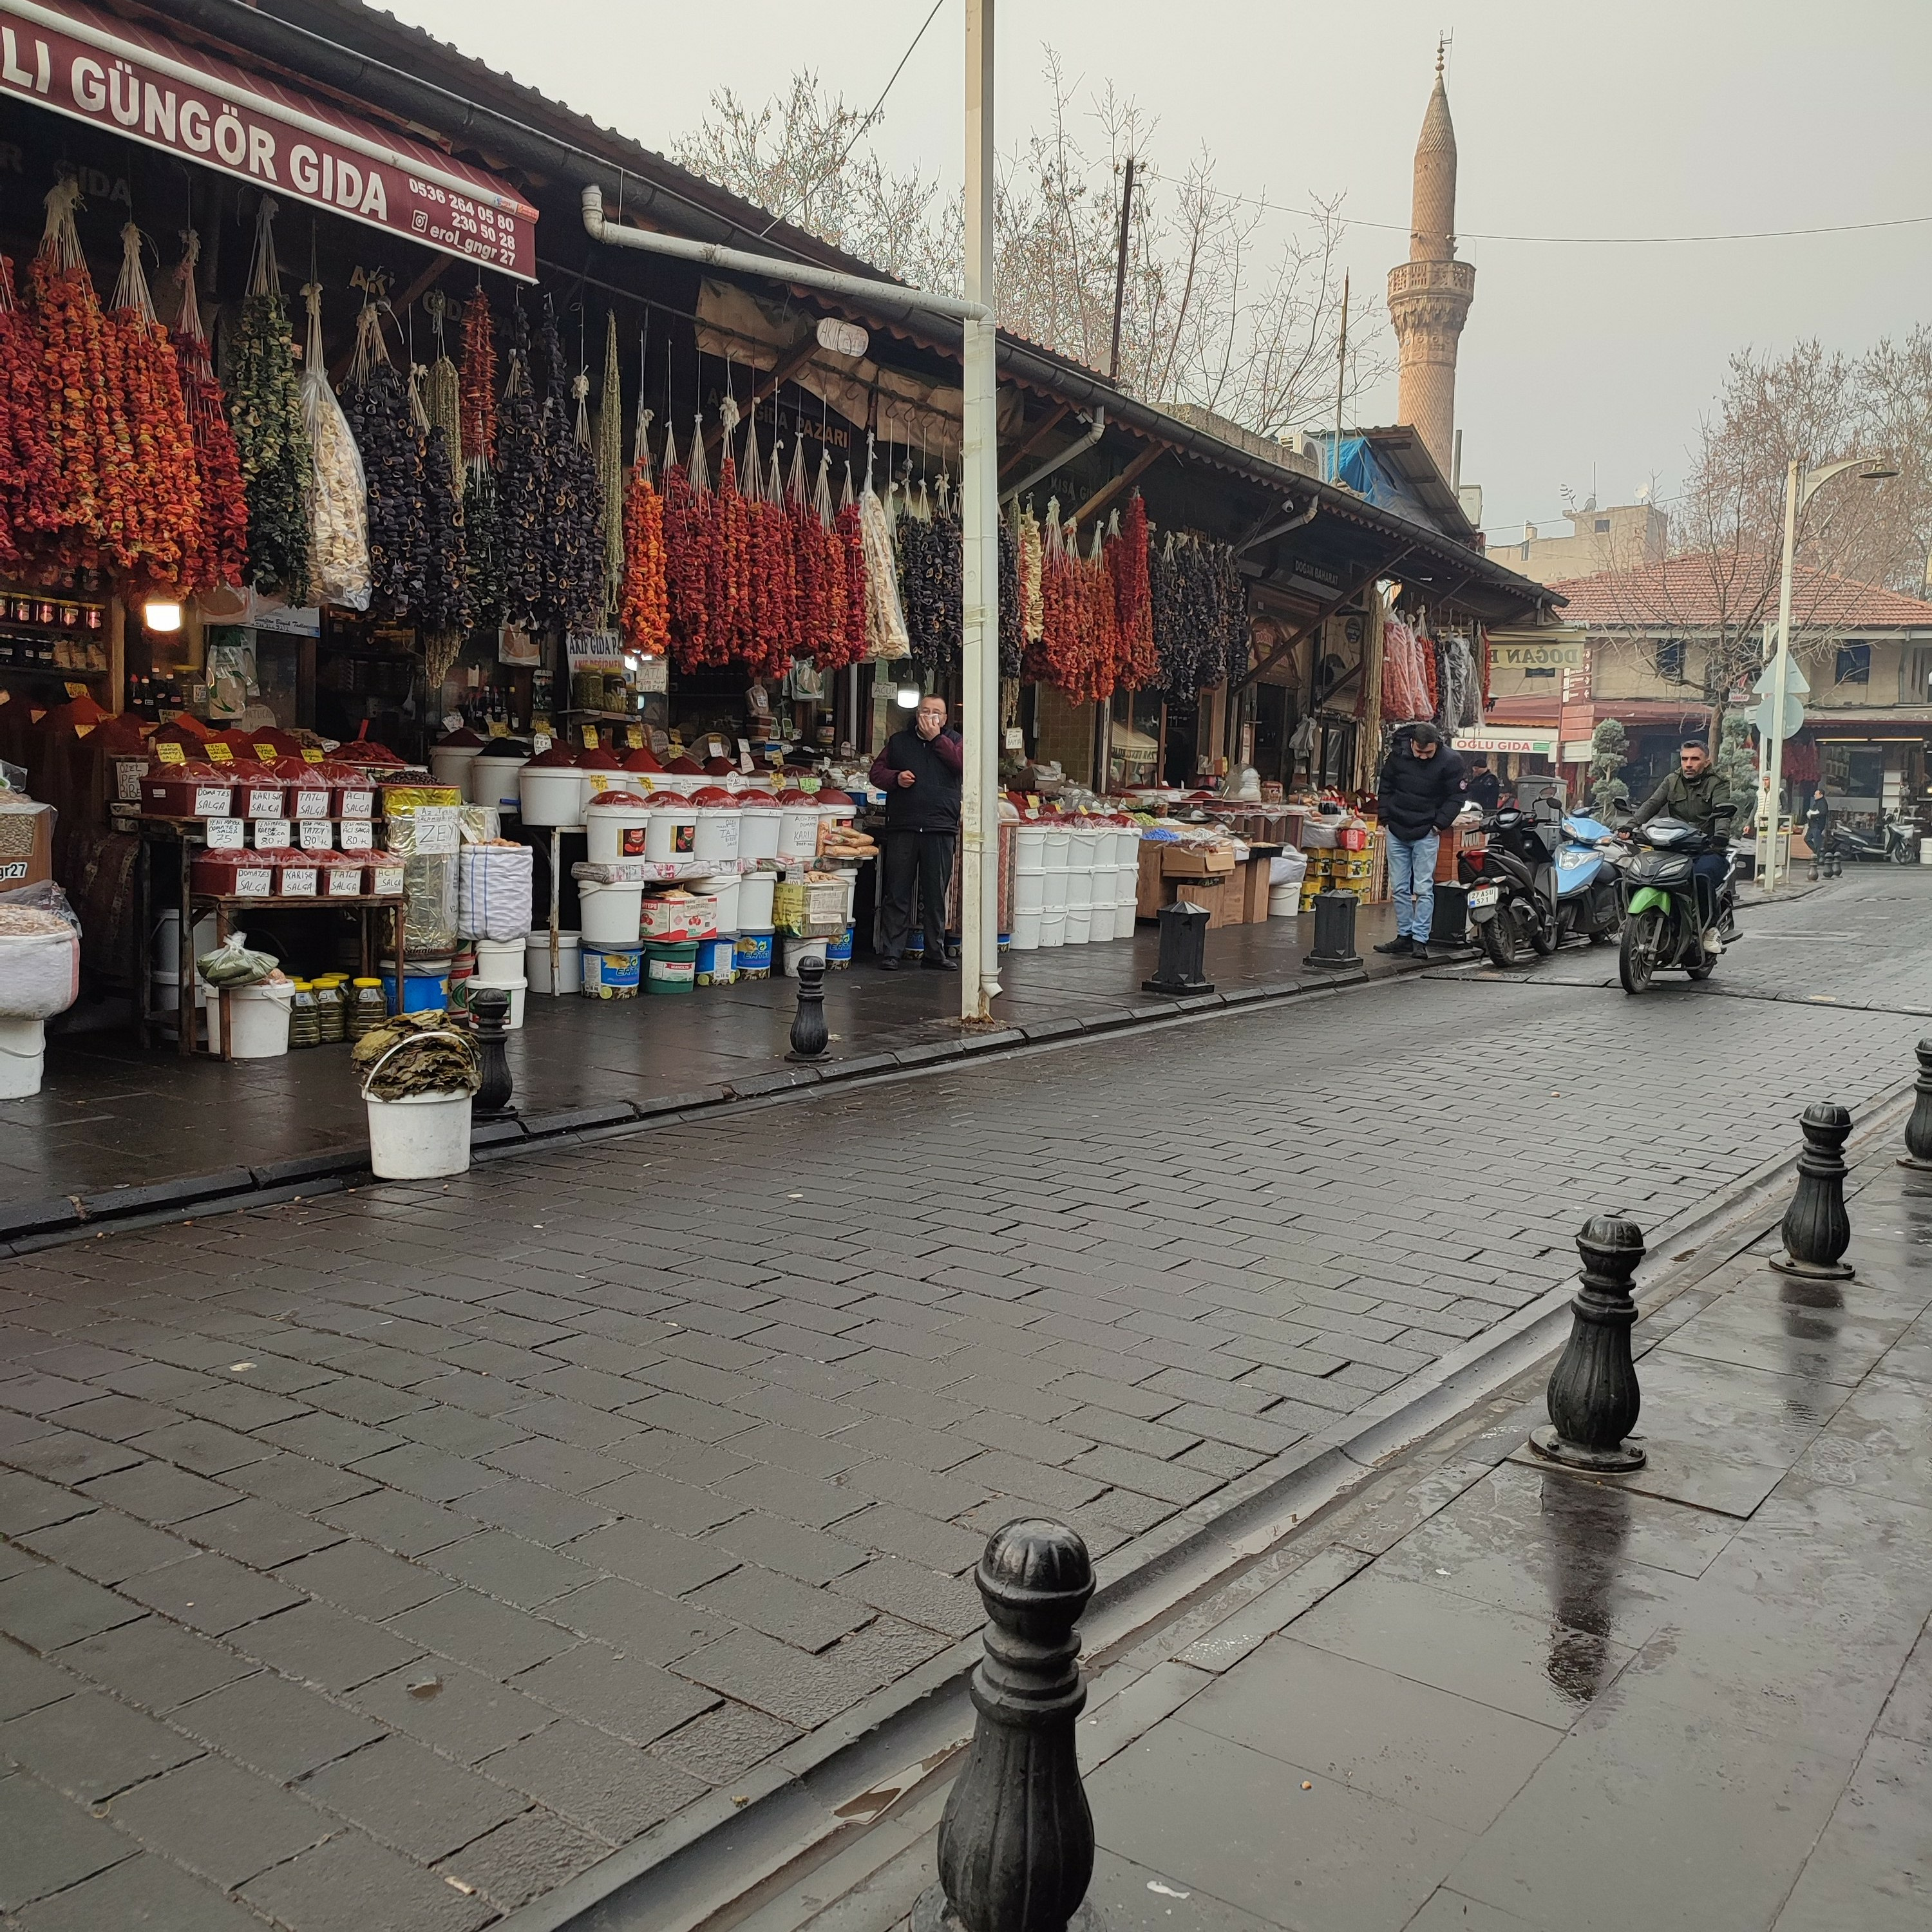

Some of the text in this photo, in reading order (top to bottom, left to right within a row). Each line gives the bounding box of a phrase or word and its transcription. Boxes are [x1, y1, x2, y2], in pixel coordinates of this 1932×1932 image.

[71, 56, 278, 182] GÜNGÖR
[290, 144, 387, 222] GIDA
[409, 178, 446, 204] 0536
[449, 194, 475, 216] 264
[478, 206, 494, 224] 05
[497, 214, 514, 232] 80
[451, 212, 515, 250] 230 50 28
[430, 225, 515, 266] erol_gngr 27
[755, 406, 849, 448] GIDA PAZARI
[1295, 560, 1314, 578] DOĞAN
[590, 636, 611, 655] GIDA
[1497, 741, 1531, 752] GIDA
[198, 788, 230, 797] DOMATES
[299, 792, 325, 802] TATLI
[346, 791, 365, 800] ACI
[303, 835, 317, 846] 80
[345, 835, 357, 845] 80
[238, 869, 270, 878] DOMATES
[332, 870, 357, 878] TATLI
[1481, 889, 1493, 898] ASU
